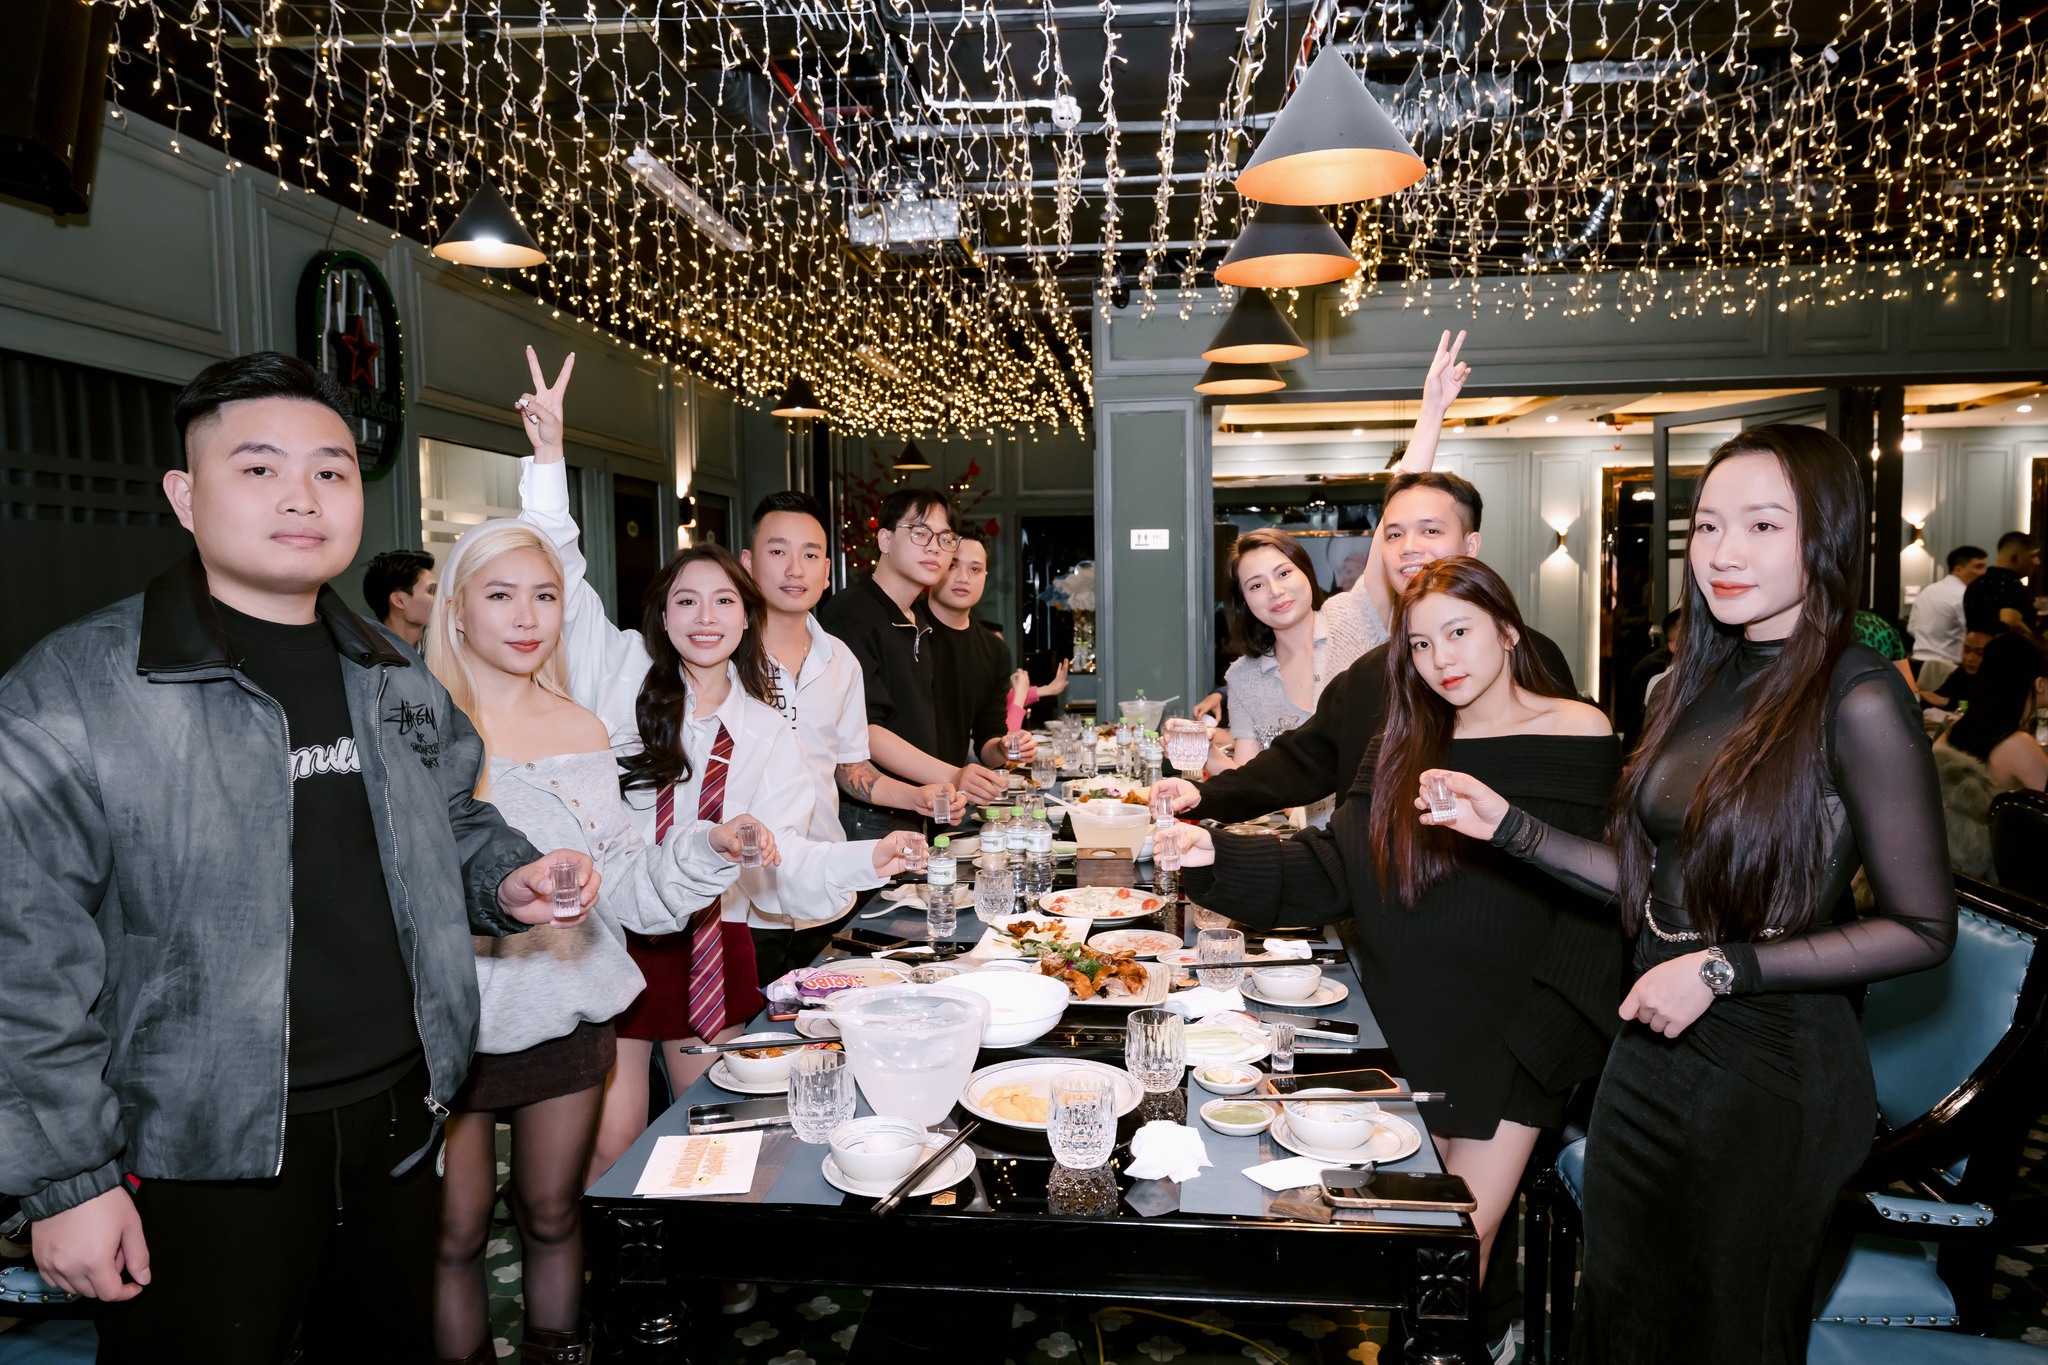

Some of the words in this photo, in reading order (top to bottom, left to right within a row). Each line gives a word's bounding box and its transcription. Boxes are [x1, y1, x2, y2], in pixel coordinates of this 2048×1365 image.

[352, 391, 398, 423] neken
[802, 976, 865, 990] HARIBO
[669, 1137, 711, 1189] BIRTHDAY
[702, 1146, 727, 1175] HAPPY
